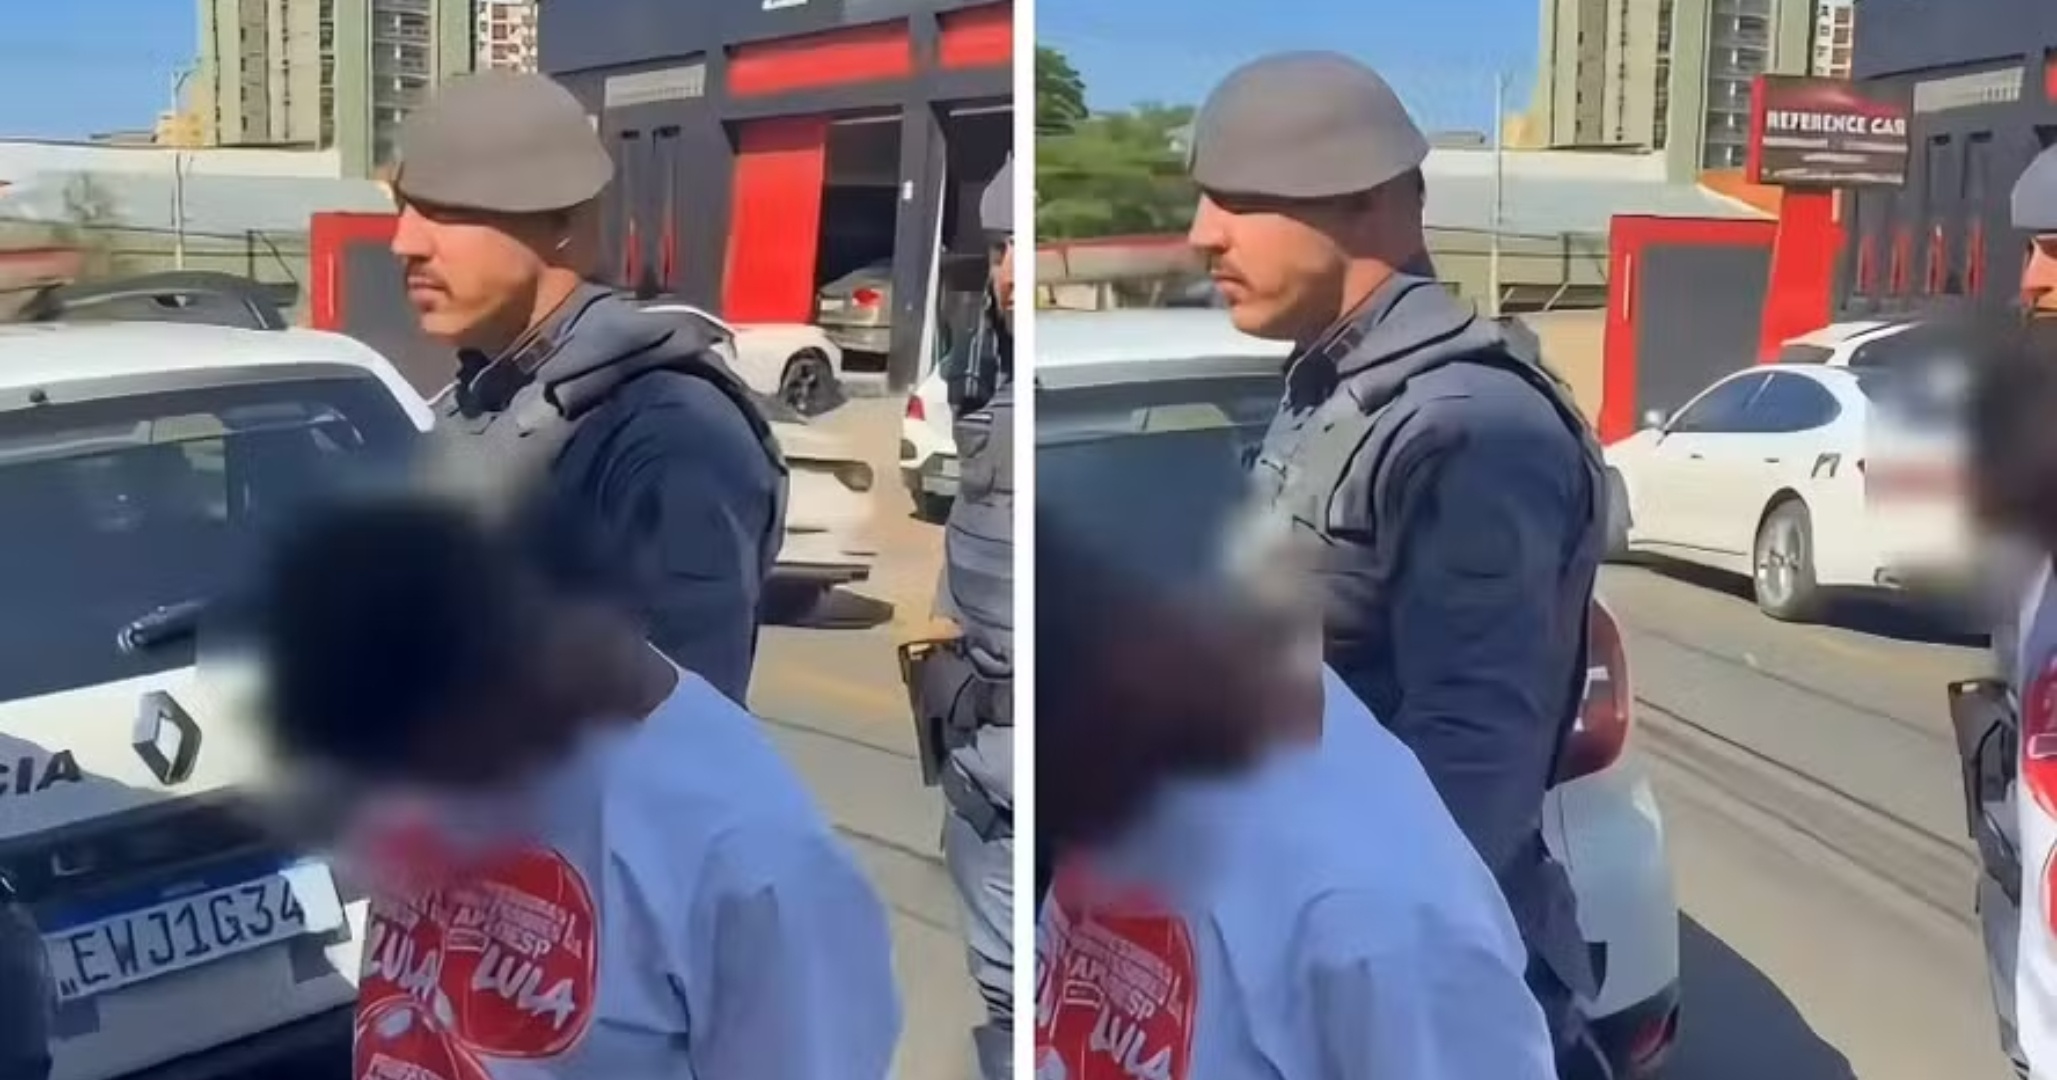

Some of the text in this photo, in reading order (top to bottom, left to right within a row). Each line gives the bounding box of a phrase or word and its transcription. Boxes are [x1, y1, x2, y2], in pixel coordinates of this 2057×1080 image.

[1767, 110, 1906, 136] REFERENCE CAR
[68, 879, 305, 986] EWJ1G34
[363, 920, 438, 1000] LULA
[472, 943, 575, 1029] LULA
